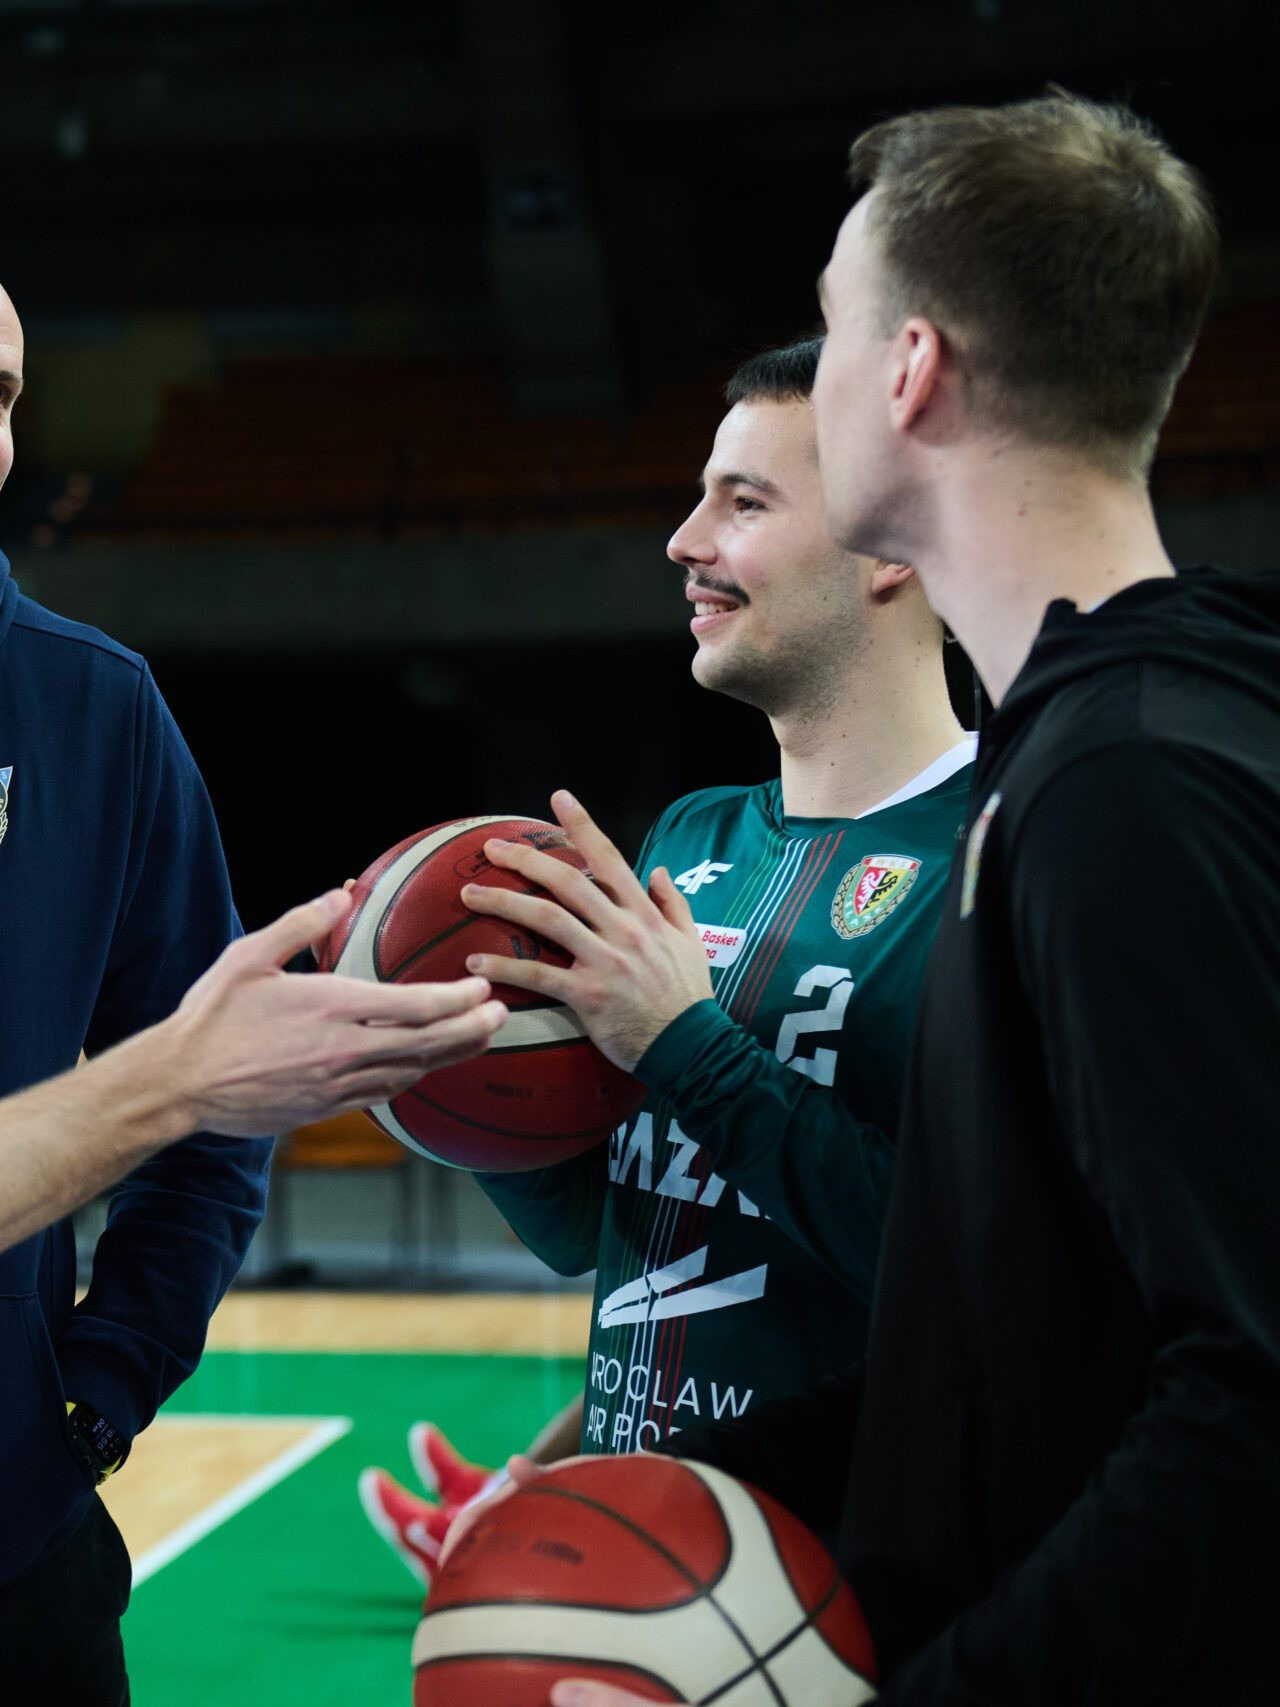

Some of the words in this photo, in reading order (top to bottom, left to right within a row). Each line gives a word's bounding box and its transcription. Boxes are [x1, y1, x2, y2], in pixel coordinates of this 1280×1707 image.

[674, 858, 735, 894] 4F
[702, 930, 739, 947] Basket
[775, 964, 855, 1088] 2
